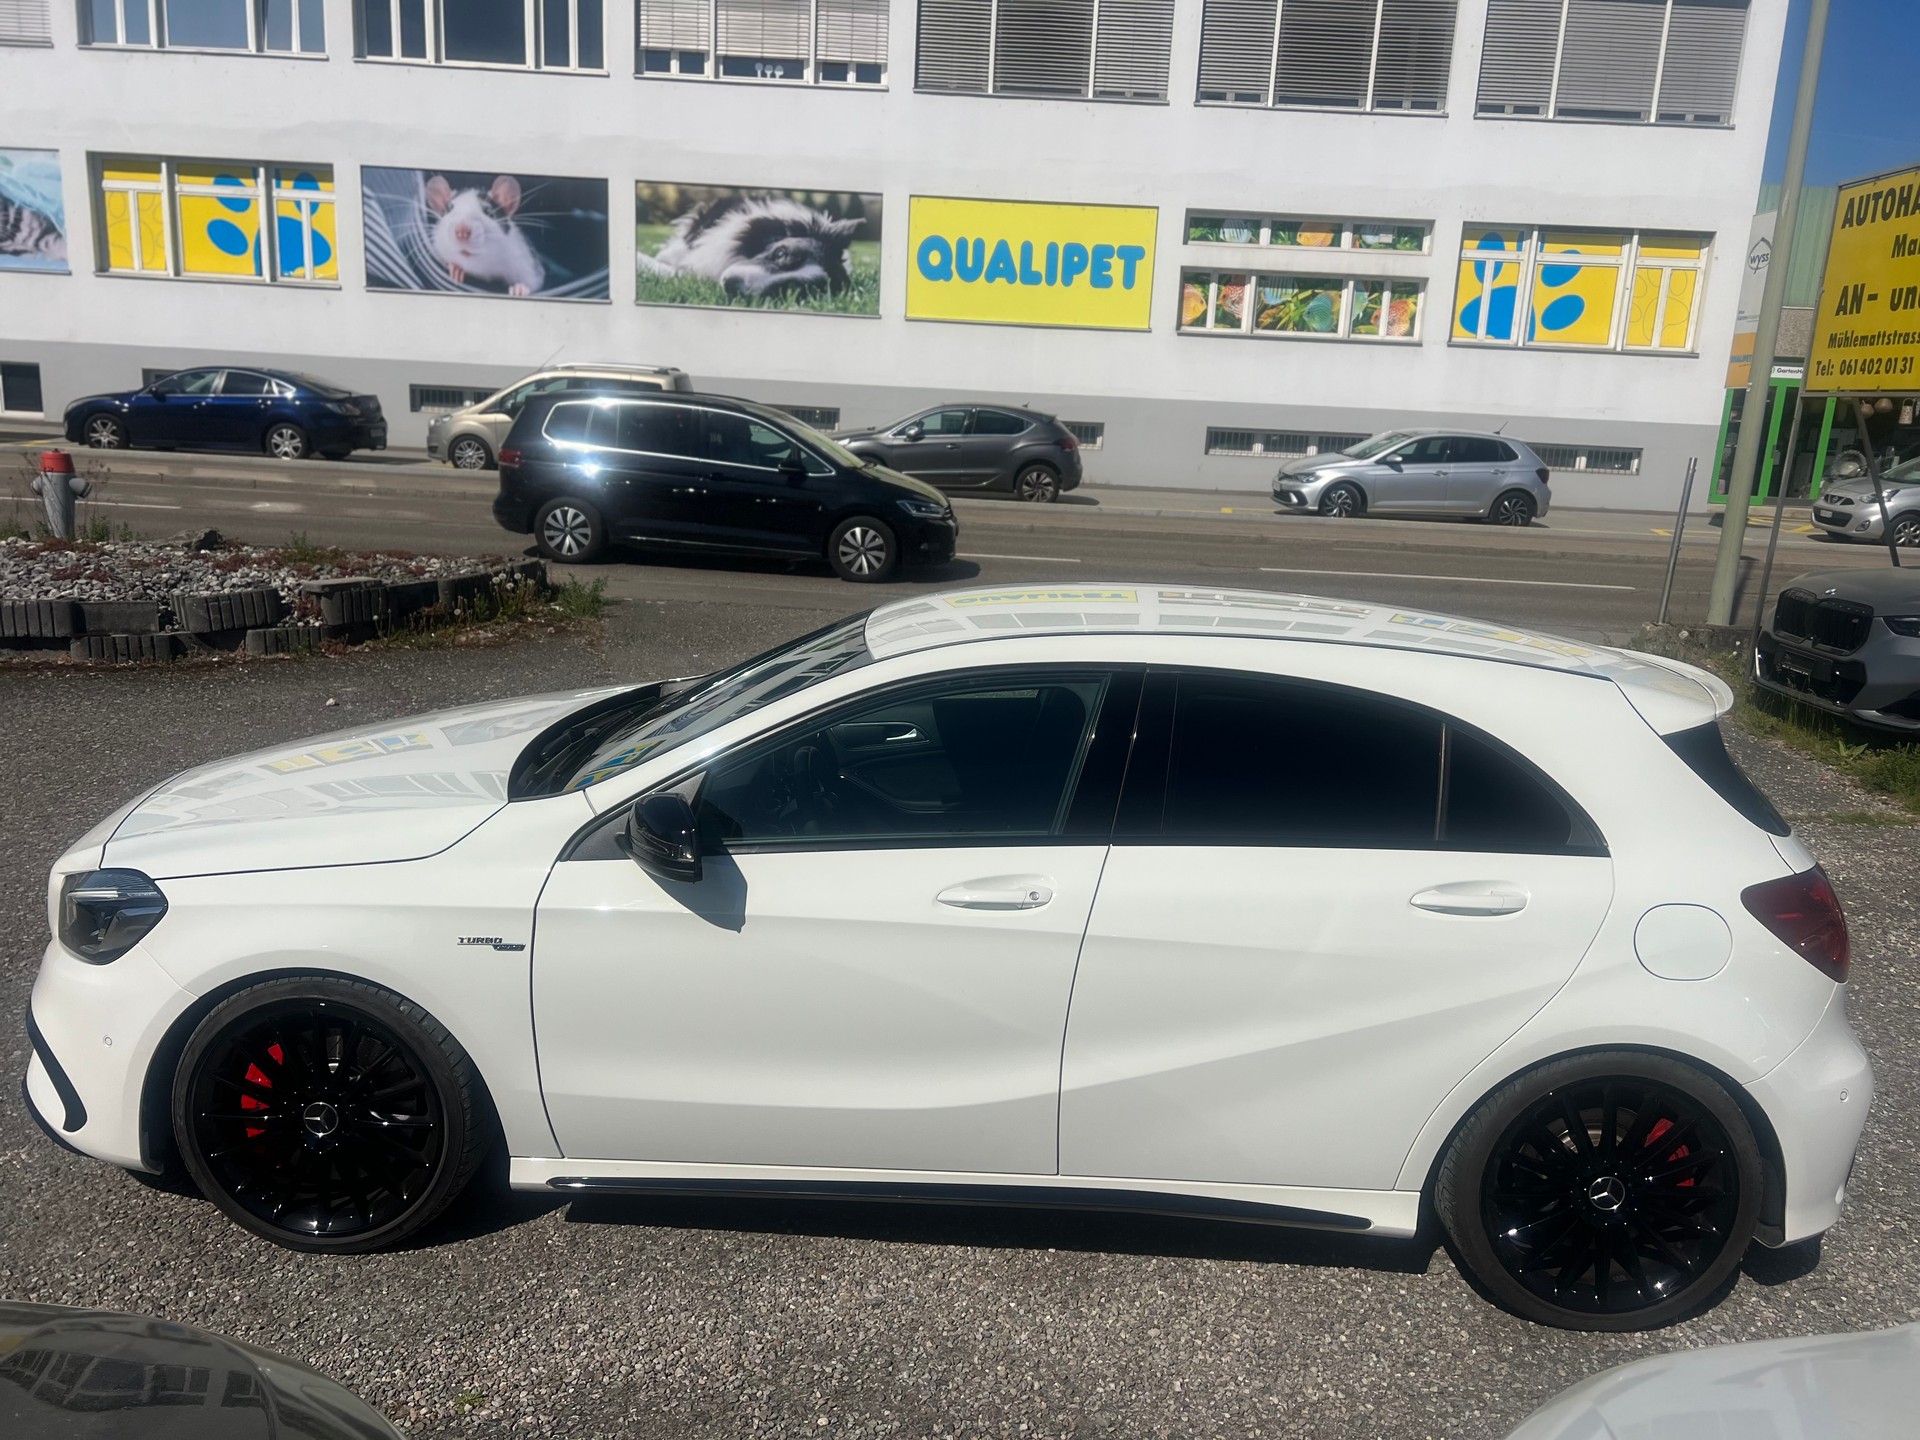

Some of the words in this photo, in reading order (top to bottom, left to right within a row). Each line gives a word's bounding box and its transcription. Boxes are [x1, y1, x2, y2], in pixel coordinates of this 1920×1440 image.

[1891, 233, 1920, 258] Ma
[917, 235, 1146, 290] QUALIPET
[1890, 285, 1920, 311] un
[1816, 359, 1834, 376] Tel:
